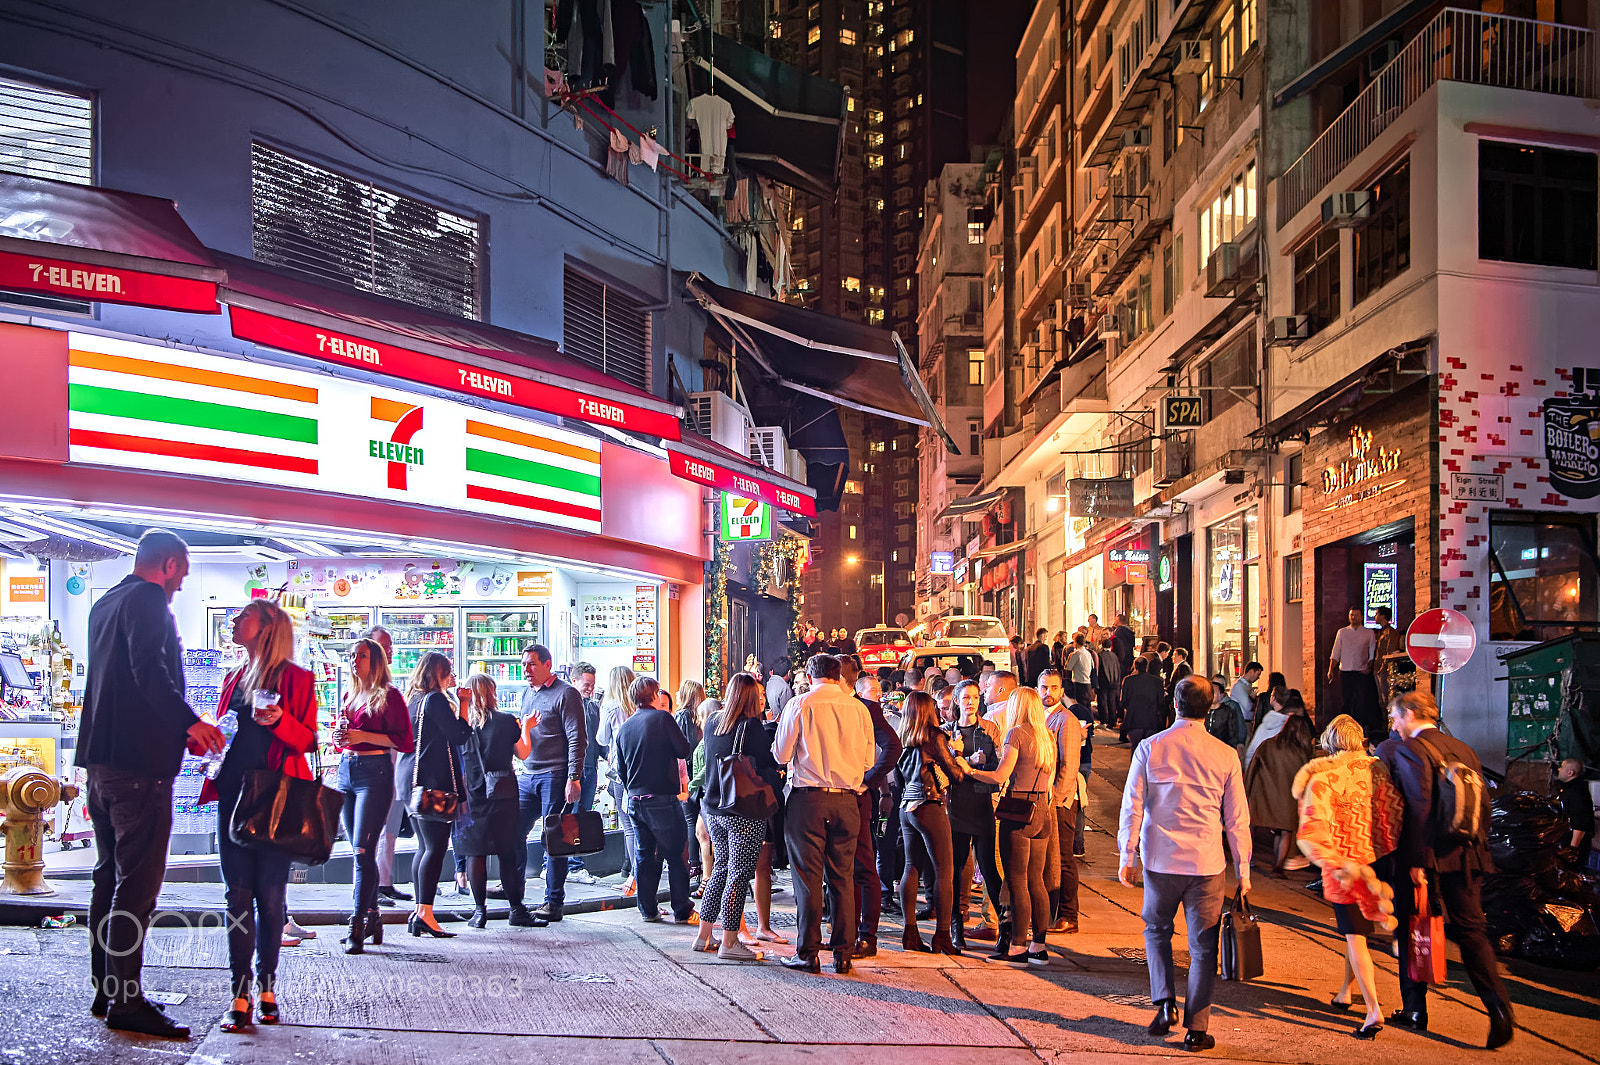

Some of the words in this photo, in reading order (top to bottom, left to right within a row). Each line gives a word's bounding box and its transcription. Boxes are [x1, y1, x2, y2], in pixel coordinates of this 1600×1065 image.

[1169, 401, 1200, 423] SPA
[1548, 412, 1570, 427] THE
[1547, 427, 1598, 459] BOILER
[1551, 449, 1598, 476] MAKER
[1456, 476, 1472, 485] Elgin
[1478, 477, 1500, 485] Street
[1458, 486, 1498, 498] 伊利近街
[1367, 580, 1392, 594] Happy
[17, 845, 35, 861] 11
